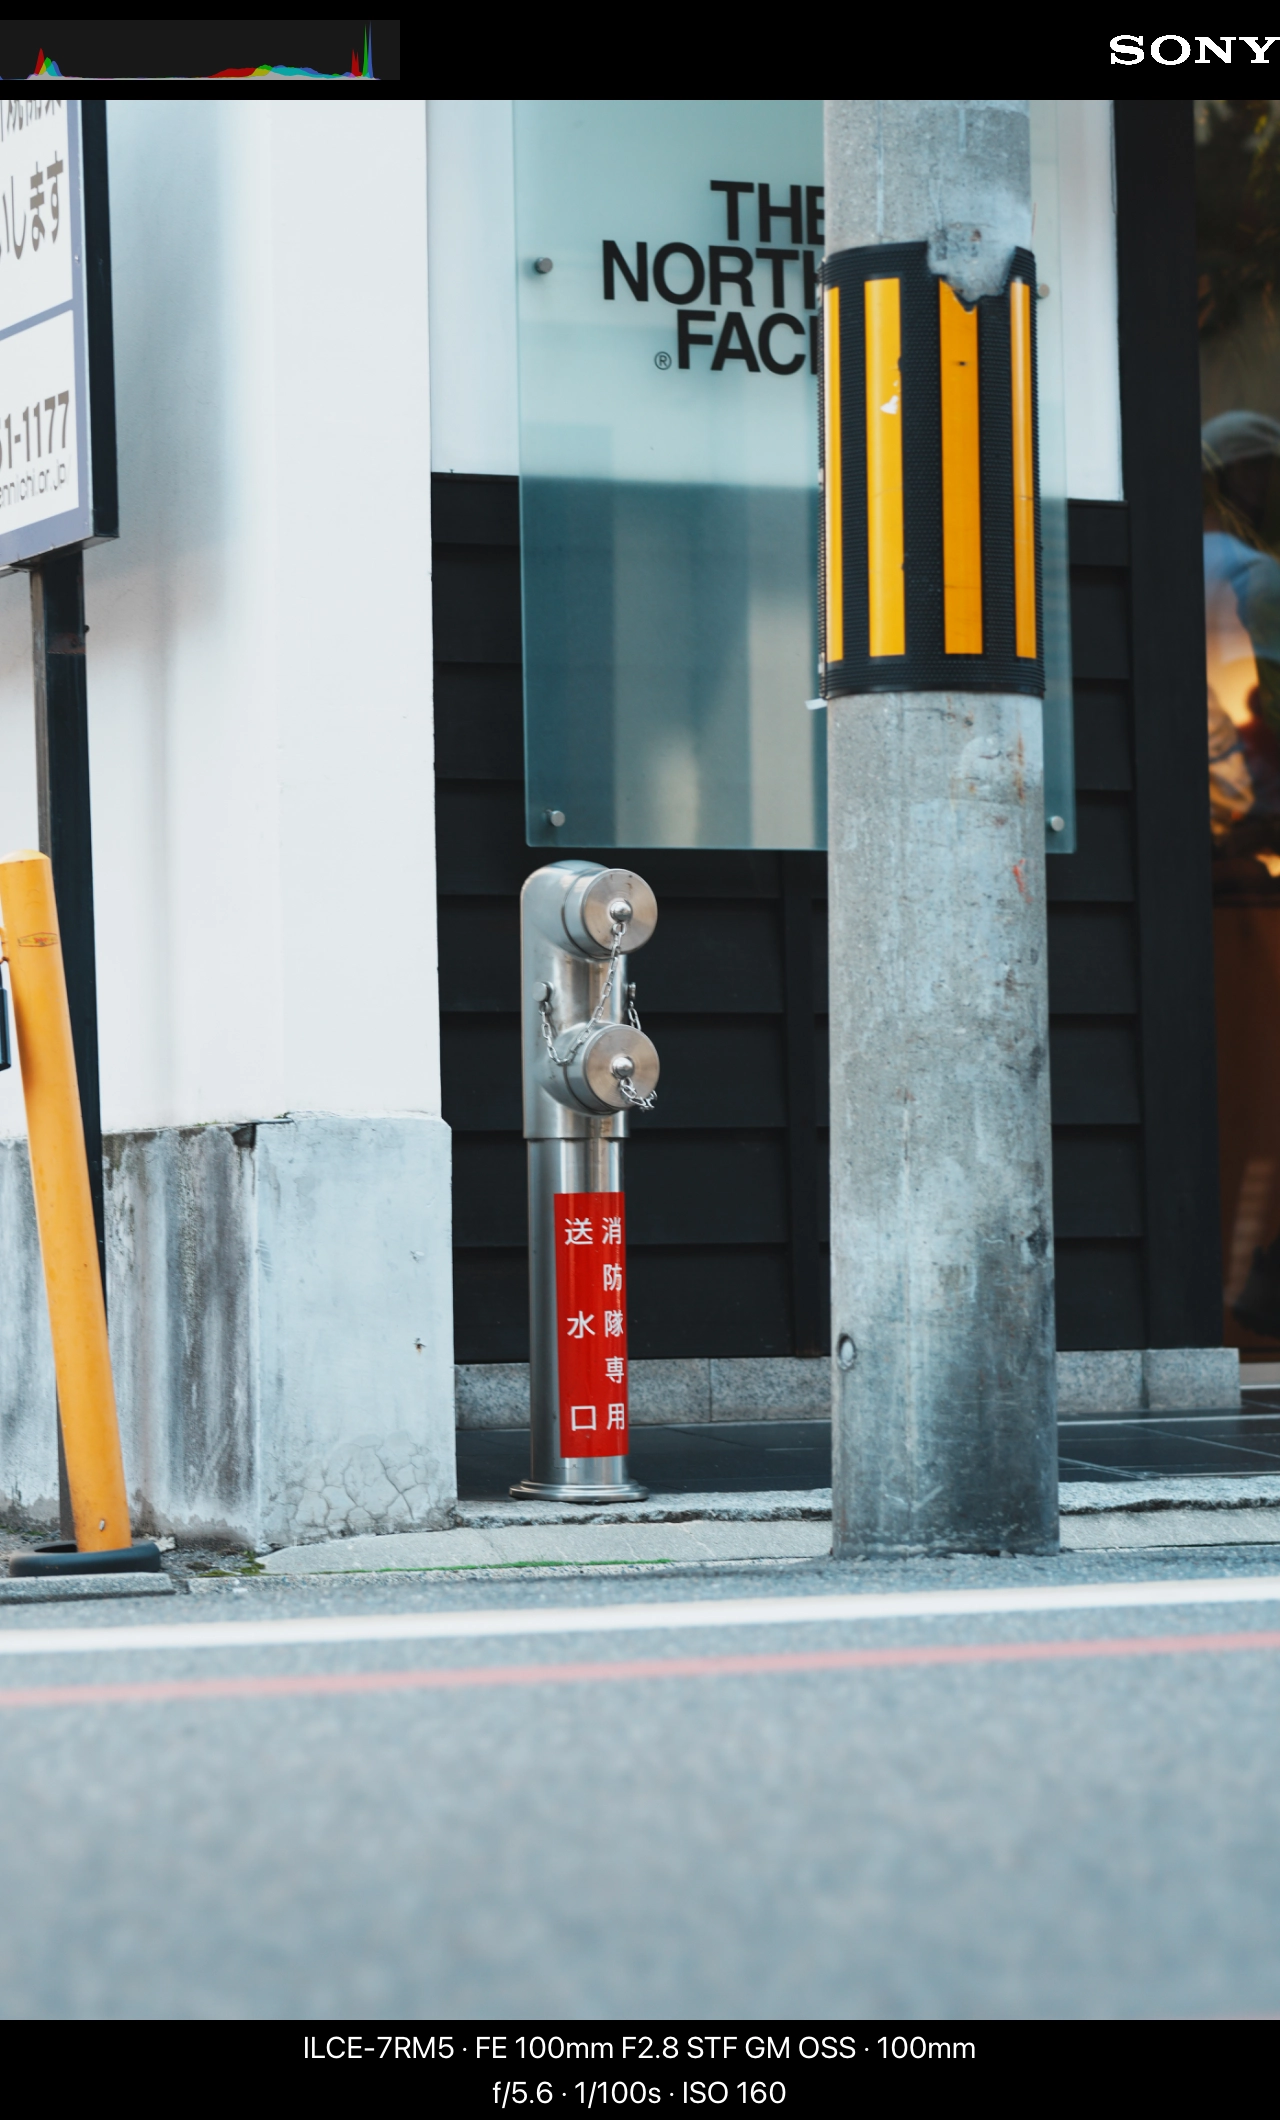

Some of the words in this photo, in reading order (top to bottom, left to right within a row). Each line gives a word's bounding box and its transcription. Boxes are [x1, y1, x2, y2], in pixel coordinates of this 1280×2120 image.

[677, 309, 819, 376] FAC
[564, 1217, 597, 1432] 送水口
[601, 1216, 626, 1431] 消防隊専用
